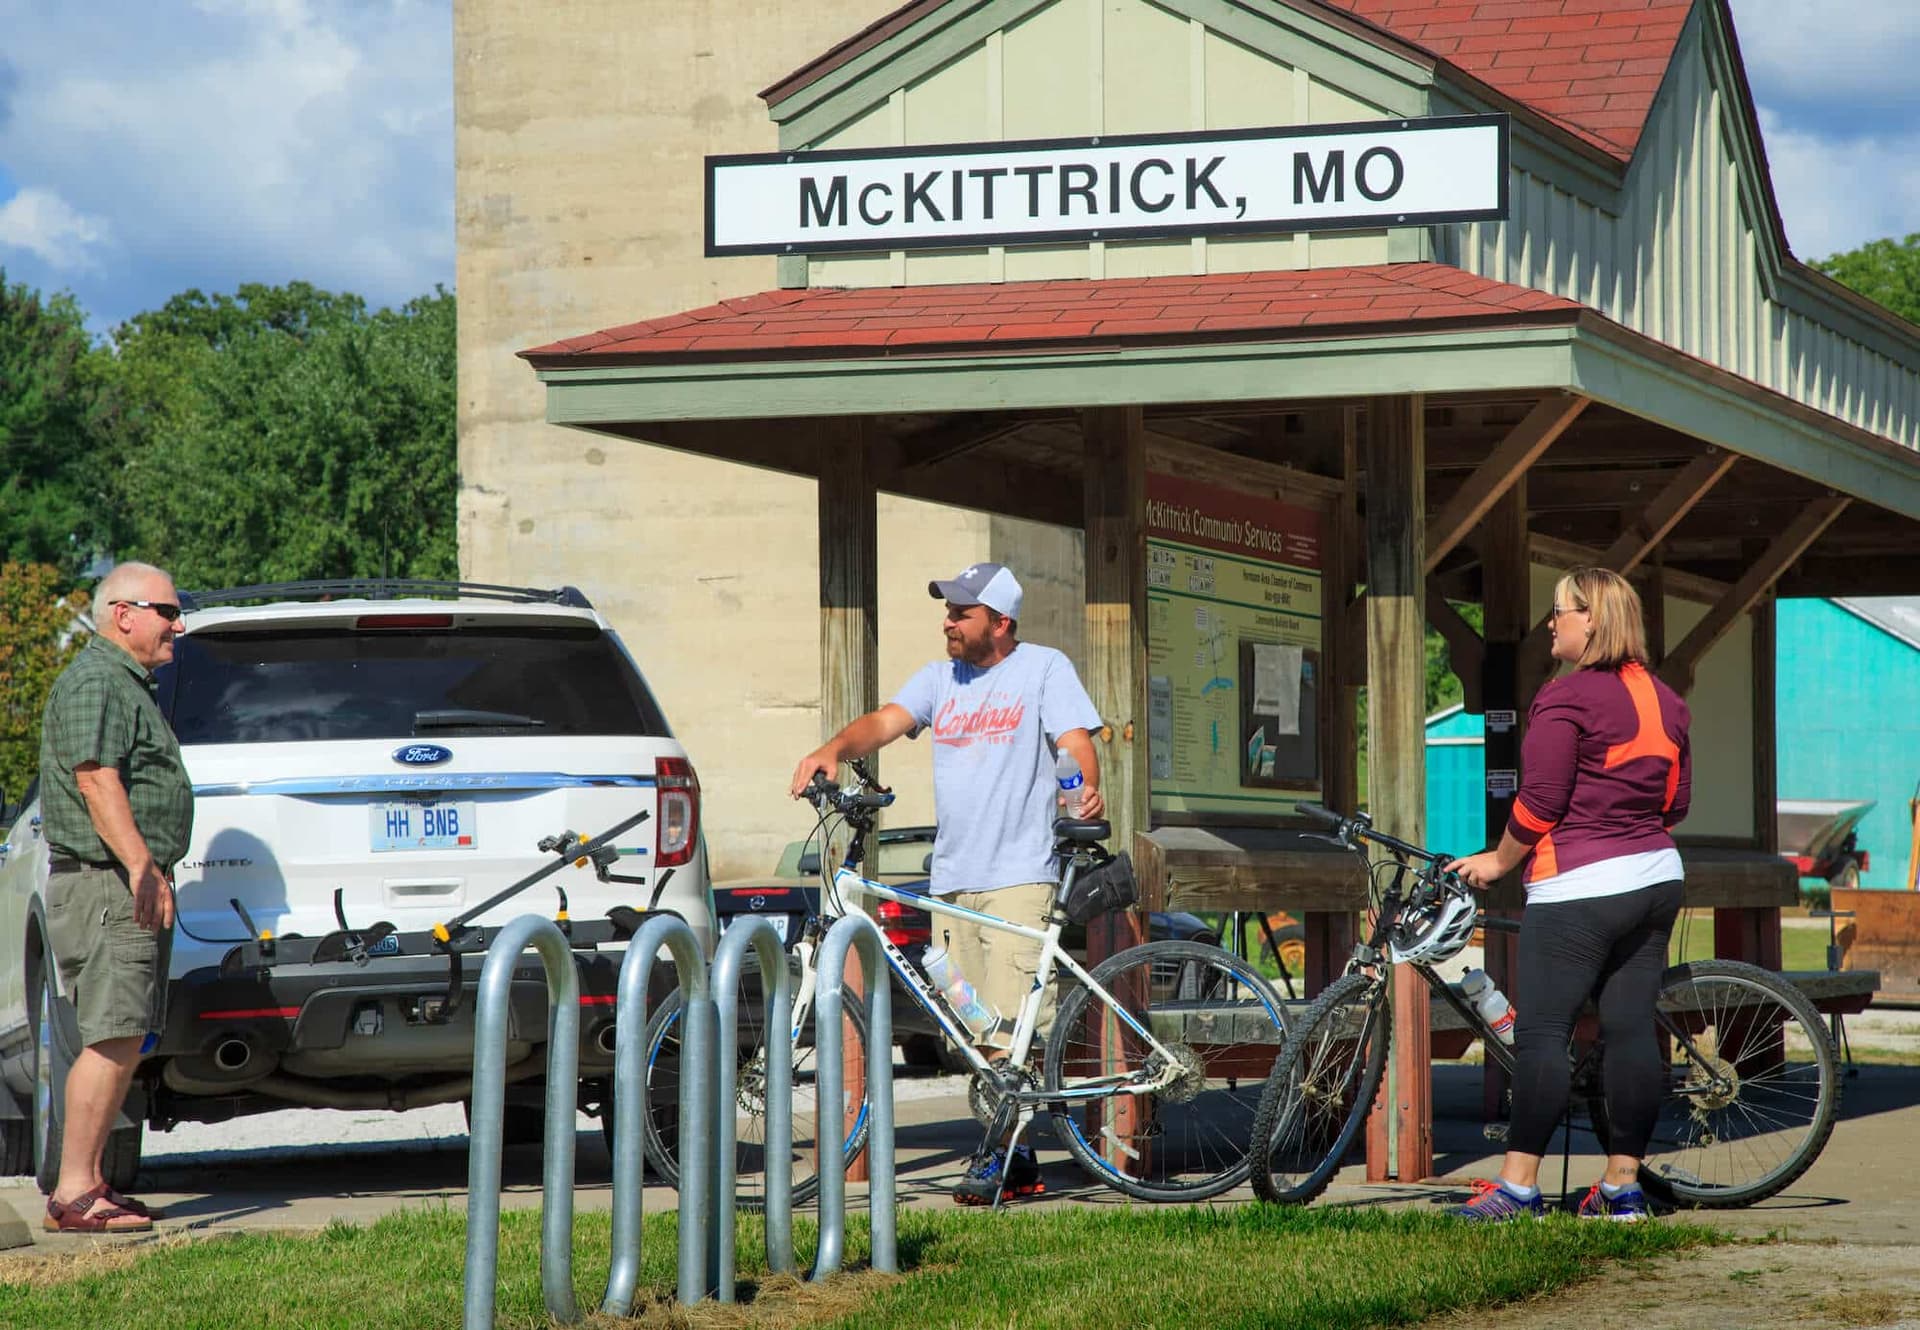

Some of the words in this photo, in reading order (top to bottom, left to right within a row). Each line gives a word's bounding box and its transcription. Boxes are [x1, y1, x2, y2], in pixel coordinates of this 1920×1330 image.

[1293, 146, 1404, 204] MO
[1193, 509, 1243, 544] Community
[1244, 520, 1282, 553] Services
[934, 694, 1025, 736] Cardinals
[405, 747, 439, 761] Ford
[386, 809, 409, 838] HH
[423, 808, 459, 836] BNB
